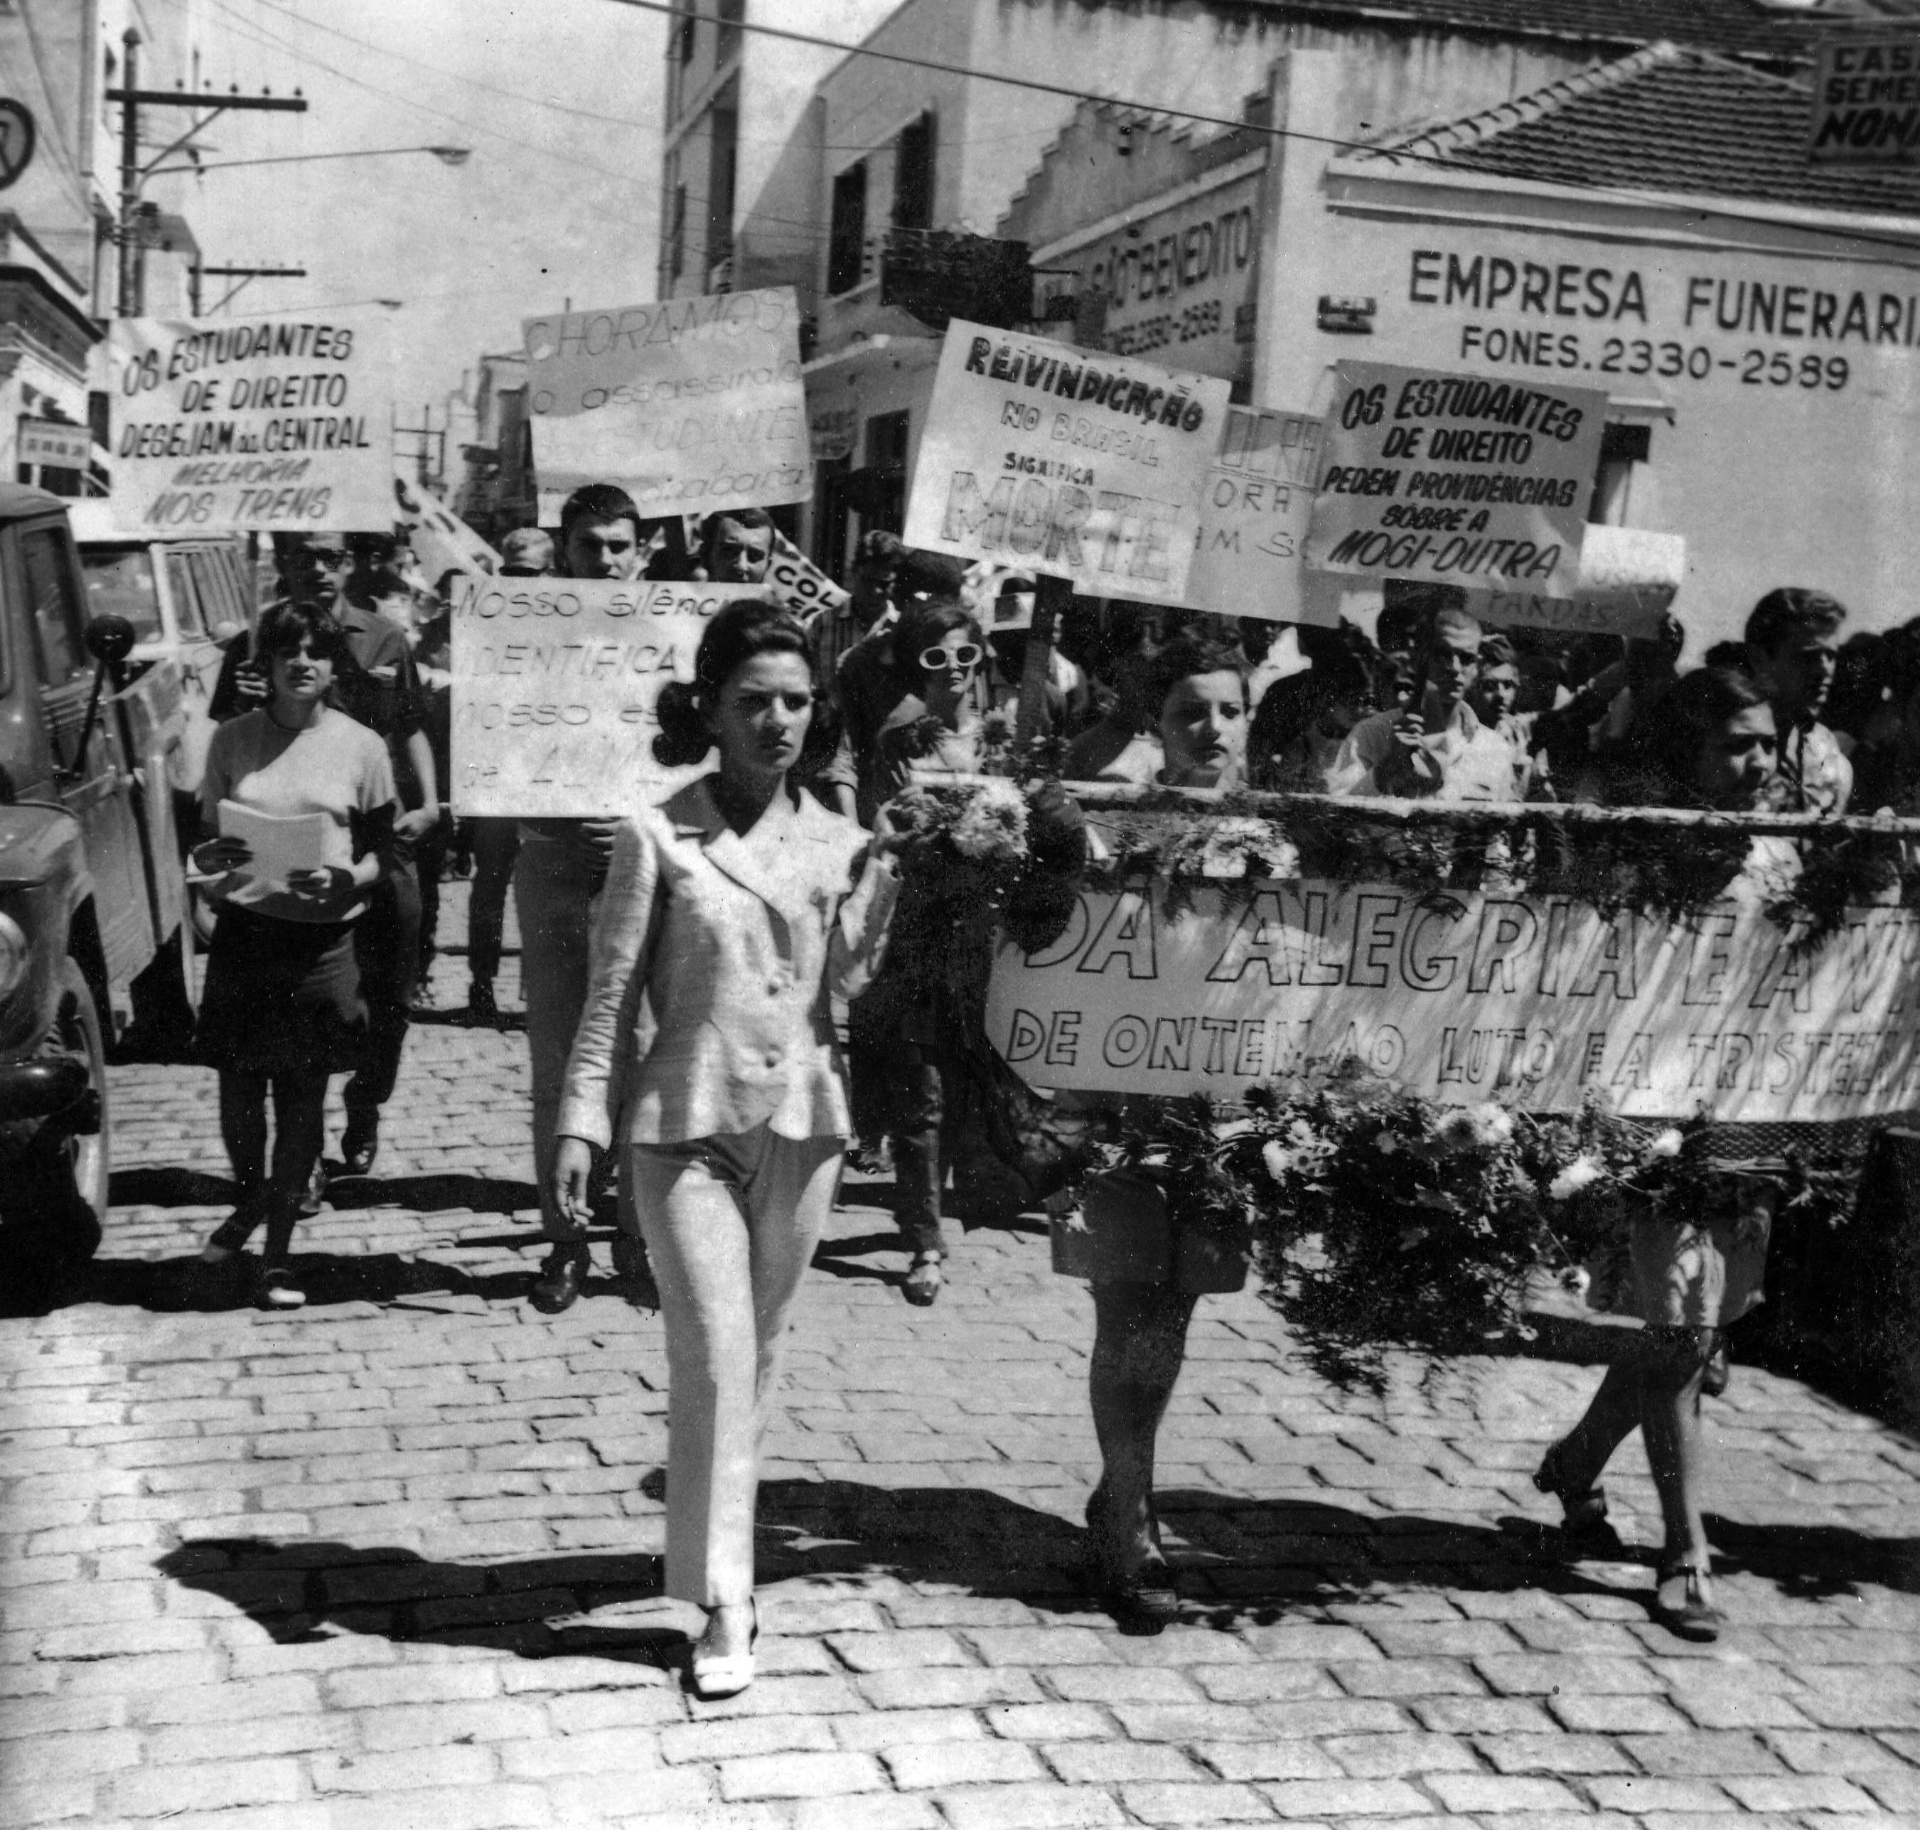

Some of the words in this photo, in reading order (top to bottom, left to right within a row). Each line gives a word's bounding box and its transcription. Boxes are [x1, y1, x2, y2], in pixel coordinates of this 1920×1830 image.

[1834, 45, 1920, 72] CAS
[1824, 77, 1920, 104] SEME
[1409, 249, 1649, 324] EMPRESA
[1684, 276, 1920, 347] FUNERARI
[525, 293, 786, 358] CHORAMOS
[123, 348, 159, 396] OS
[167, 322, 354, 380] ESTUDANTES
[181, 378, 220, 413] DE
[229, 373, 348, 411] DIREITO
[965, 336, 1205, 433] REIVINDICAÇÃO
[1341, 383, 1387, 430] OS
[1394, 378, 1583, 442] ESTUDANTES
[119, 420, 235, 459] DESEJAM
[264, 416, 371, 452] CENTRAL
[1000, 400, 1040, 431] NO
[1051, 412, 1160, 466] BRASIL
[1381, 426, 1424, 459] DE
[1427, 428, 1533, 464] DIREITO
[171, 456, 311, 486] MELHORIA
[1003, 451, 1094, 487] SIGNIFICA
[1322, 465, 1402, 497] PEDEM
[143, 491, 216, 525] NOS
[232, 486, 333, 520] TRENS
[940, 469, 1183, 583] MORTE
[1468, 509, 1490, 533] A
[1327, 529, 1562, 579] MOGI-DUTRA
[466, 645, 678, 678] DENTIFICA
[1205, 889, 1637, 1000] ALEGRIA
[1681, 913, 1737, 1006] E
[1006, 1008, 1082, 1066] DE
[1102, 1013, 1313, 1080] ONTEM
[1437, 1027, 1556, 1088] LUTO
[1577, 1031, 1606, 1086] E
[1611, 1032, 1653, 1089] A
